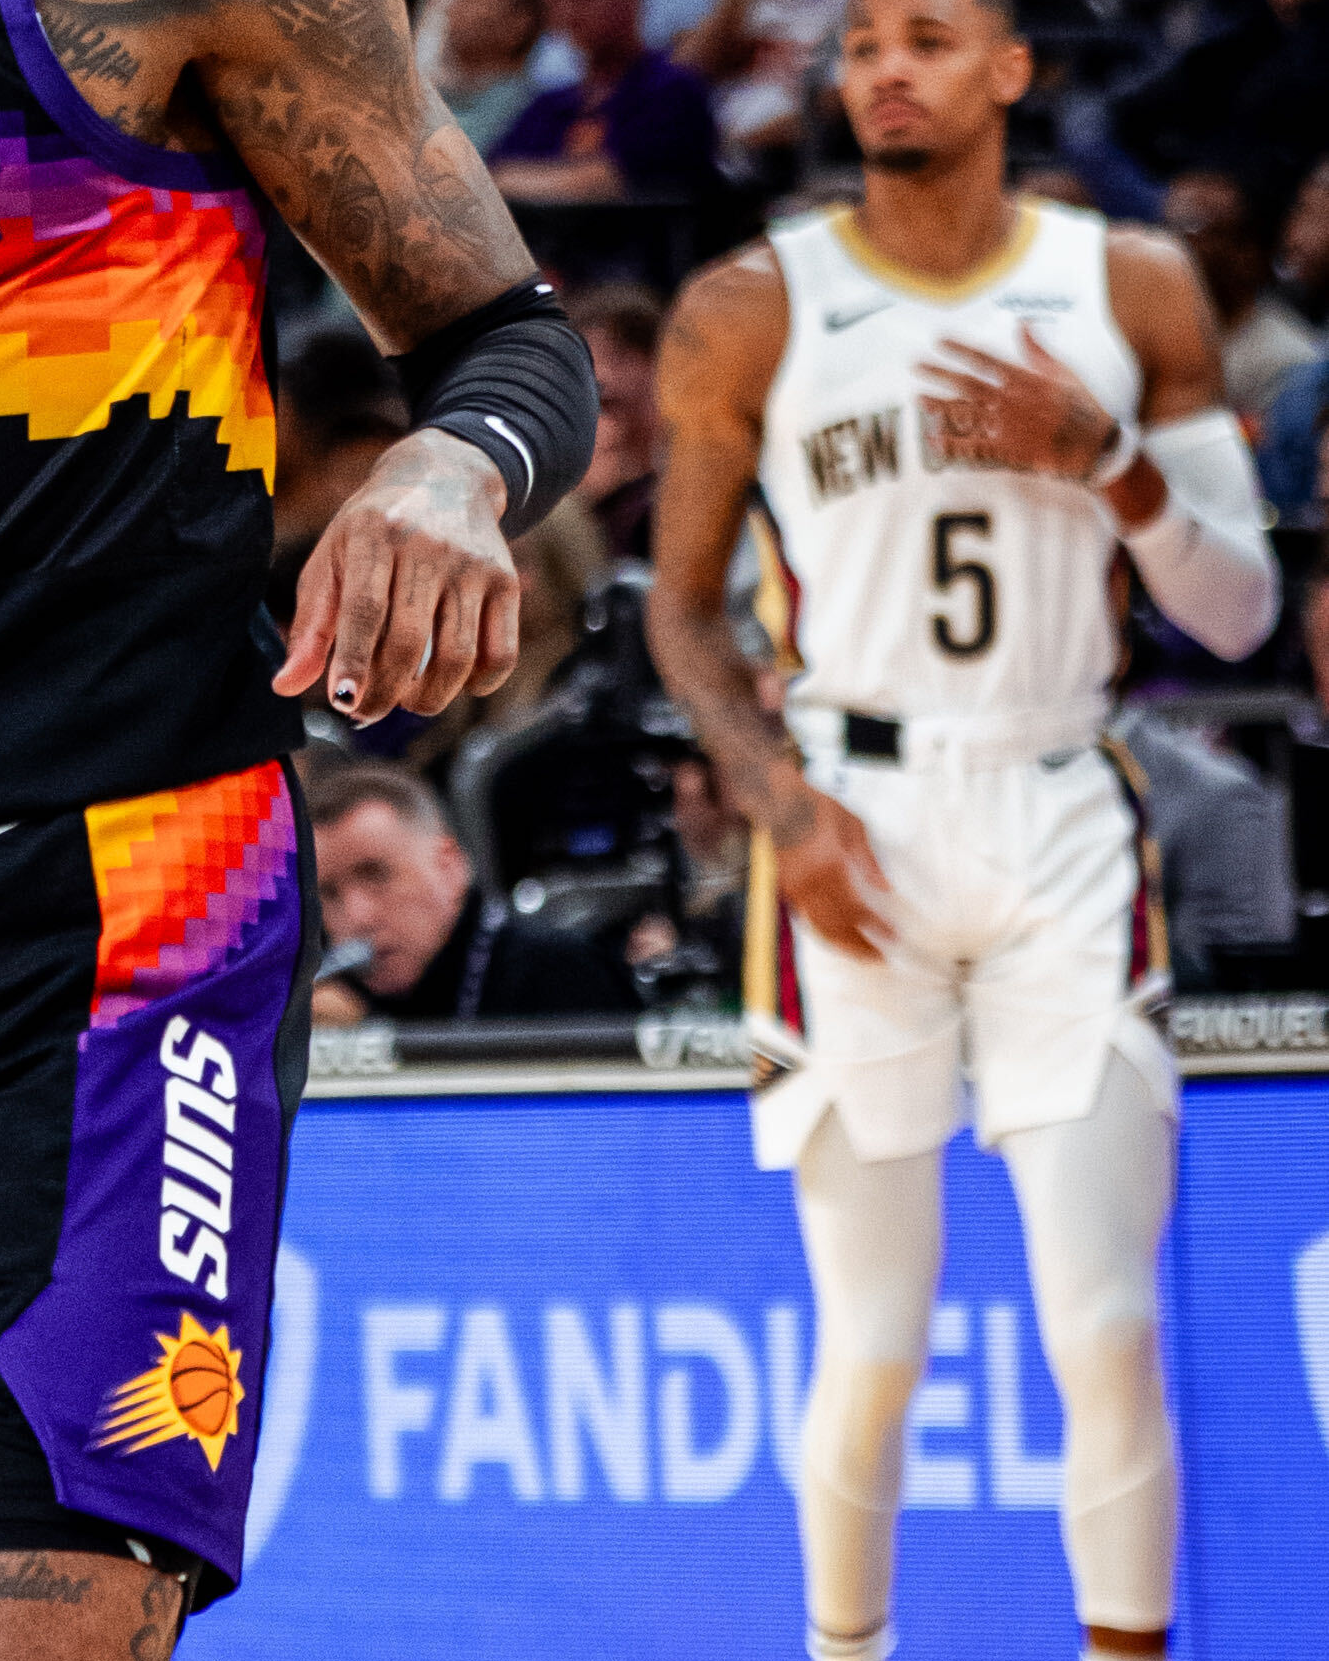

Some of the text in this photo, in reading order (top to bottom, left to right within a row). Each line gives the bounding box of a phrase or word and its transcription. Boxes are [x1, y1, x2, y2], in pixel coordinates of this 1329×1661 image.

[803, 406, 902, 502] NEW
[929, 511, 997, 658] 5
[159, 1014, 237, 1301] SUNS
